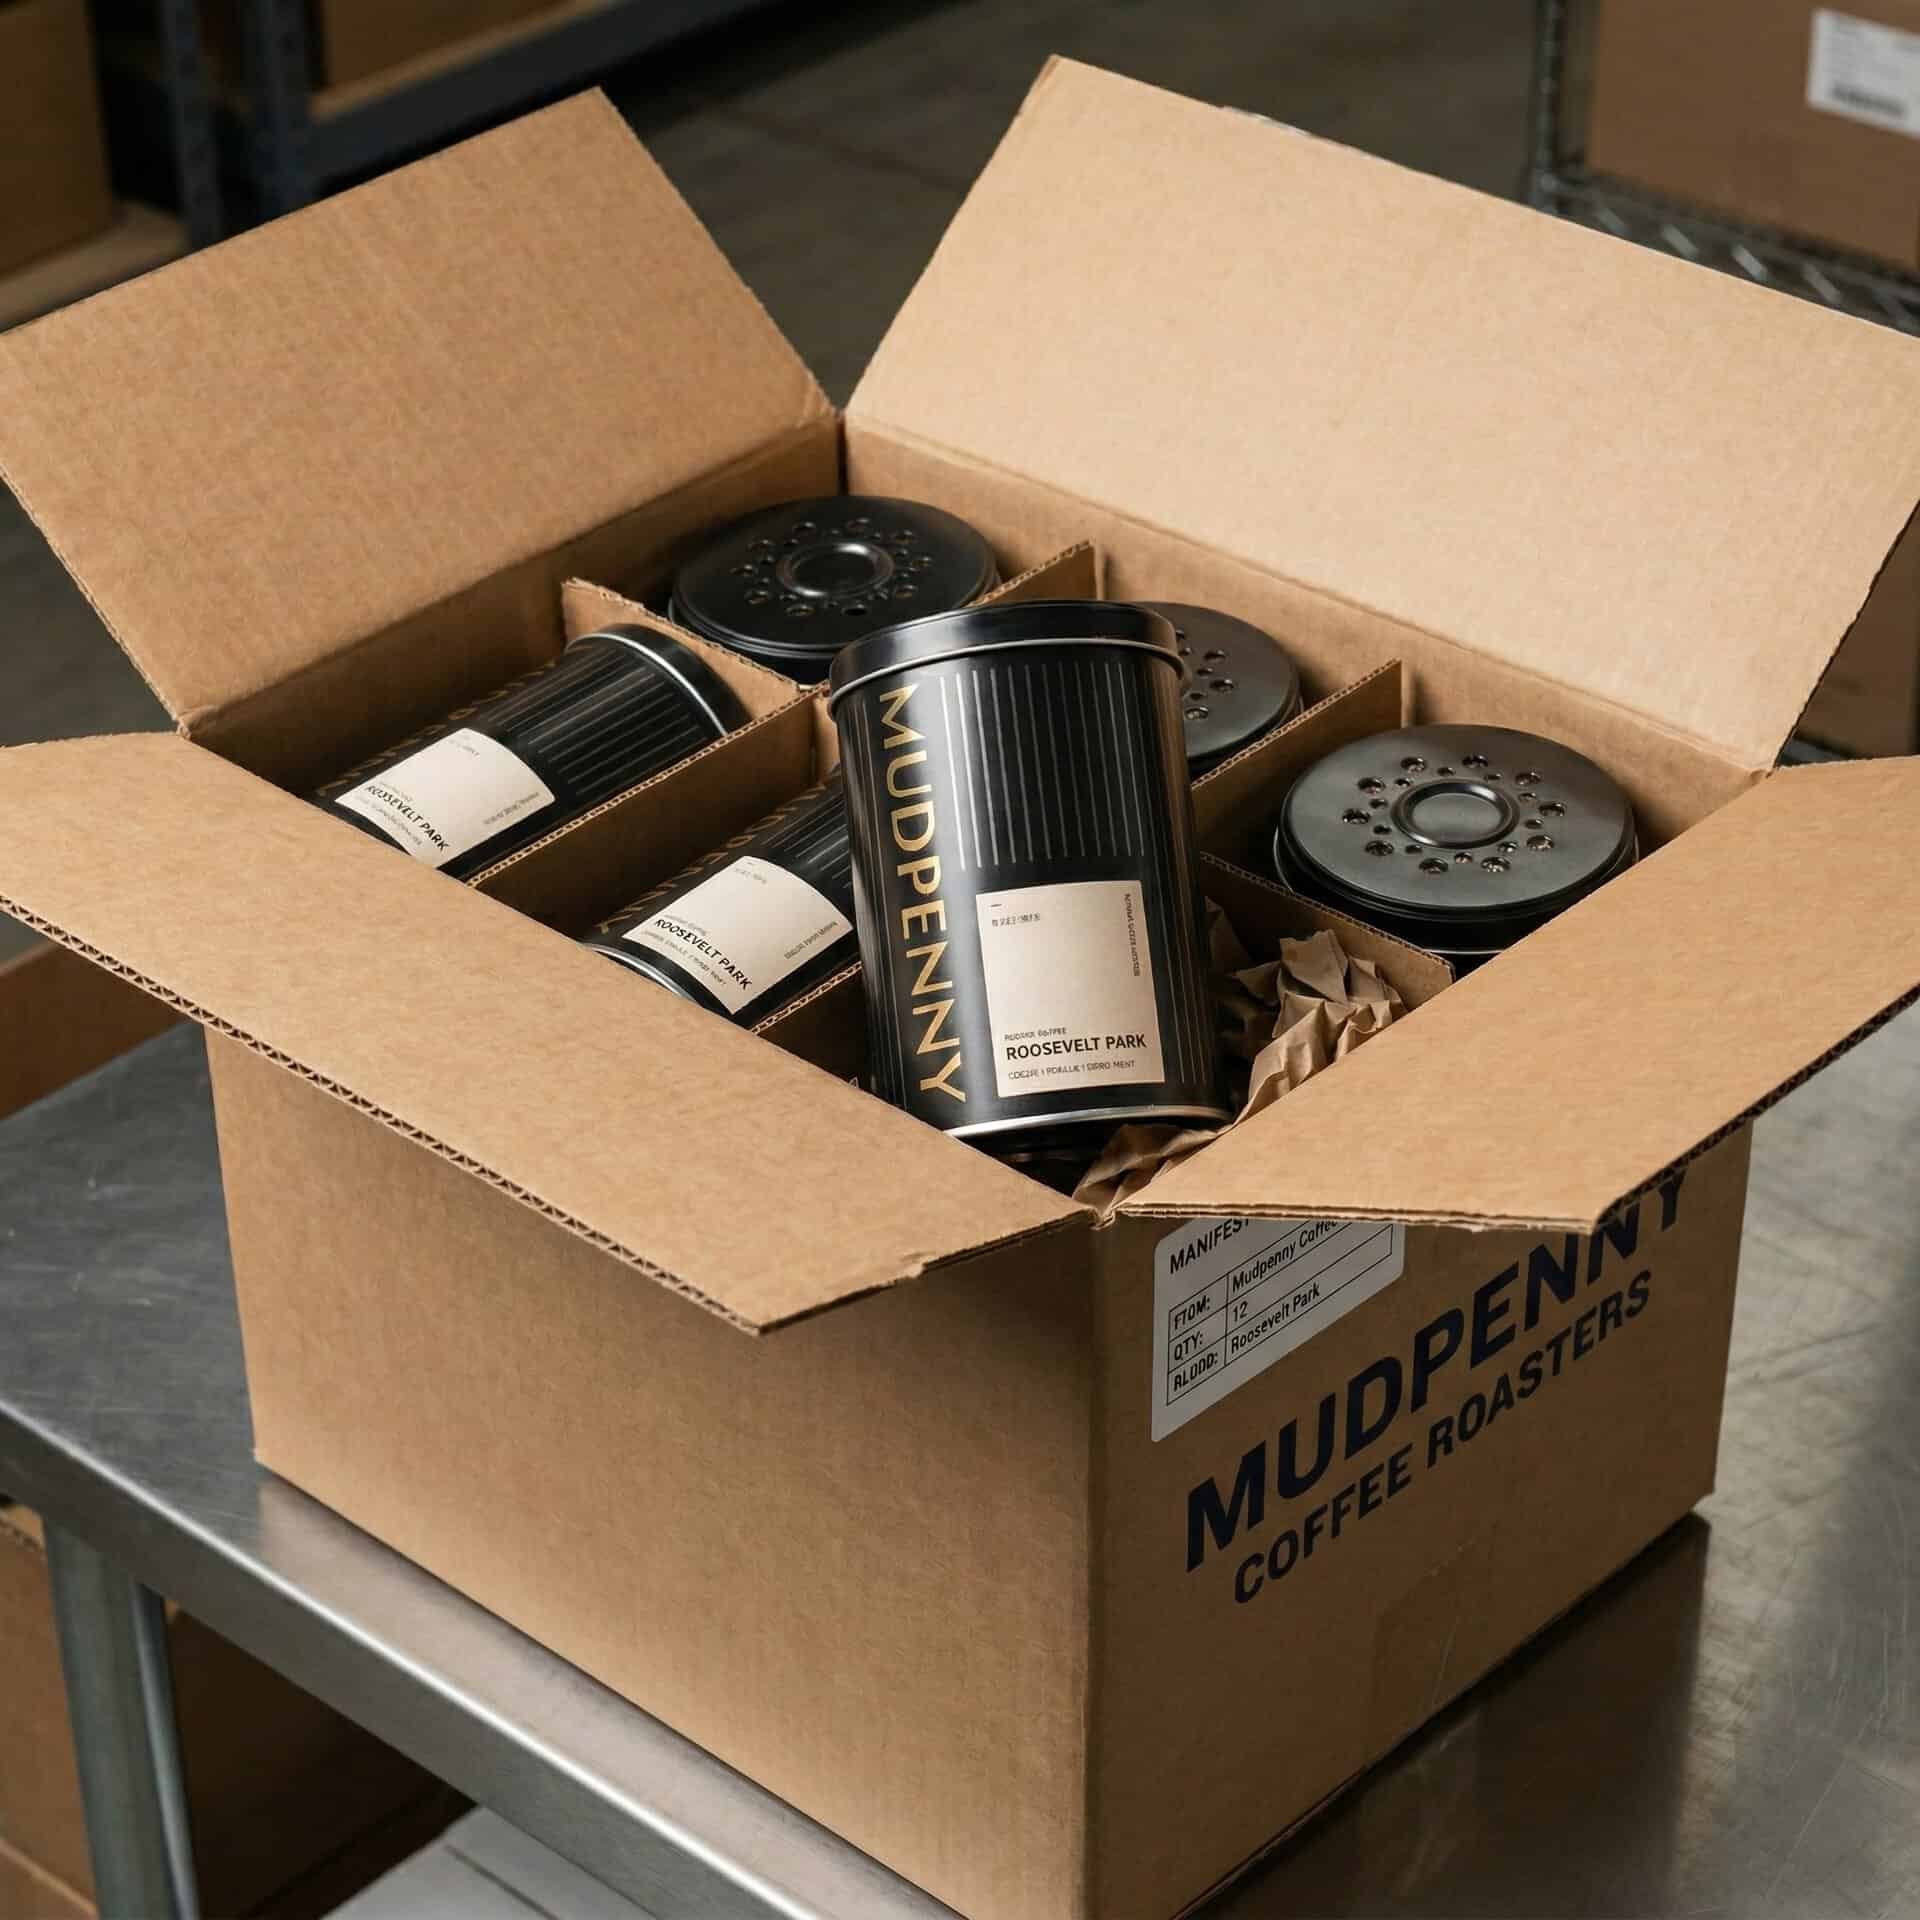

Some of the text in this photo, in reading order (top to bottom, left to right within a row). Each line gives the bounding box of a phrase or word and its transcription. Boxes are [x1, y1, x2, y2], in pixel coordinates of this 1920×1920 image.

[420, 821, 449, 852] PARK
[879, 682, 967, 1103] MUDPENNY
[654, 918, 722, 960] ROOSEVELT
[718, 957, 753, 991] PARK
[1006, 1033, 1148, 1061] ROOSEVELT PARK
[1232, 1240, 1297, 1294] Mudpenny
[1231, 1282, 1320, 1355] Roosevelt Park
[1233, 1302, 1248, 1323] 12
[1174, 1331, 1203, 1362] QTY:
[1186, 1168, 1689, 1574] MUDPENNY
[1234, 1269, 1652, 1605] COFFEE ROASTERS
